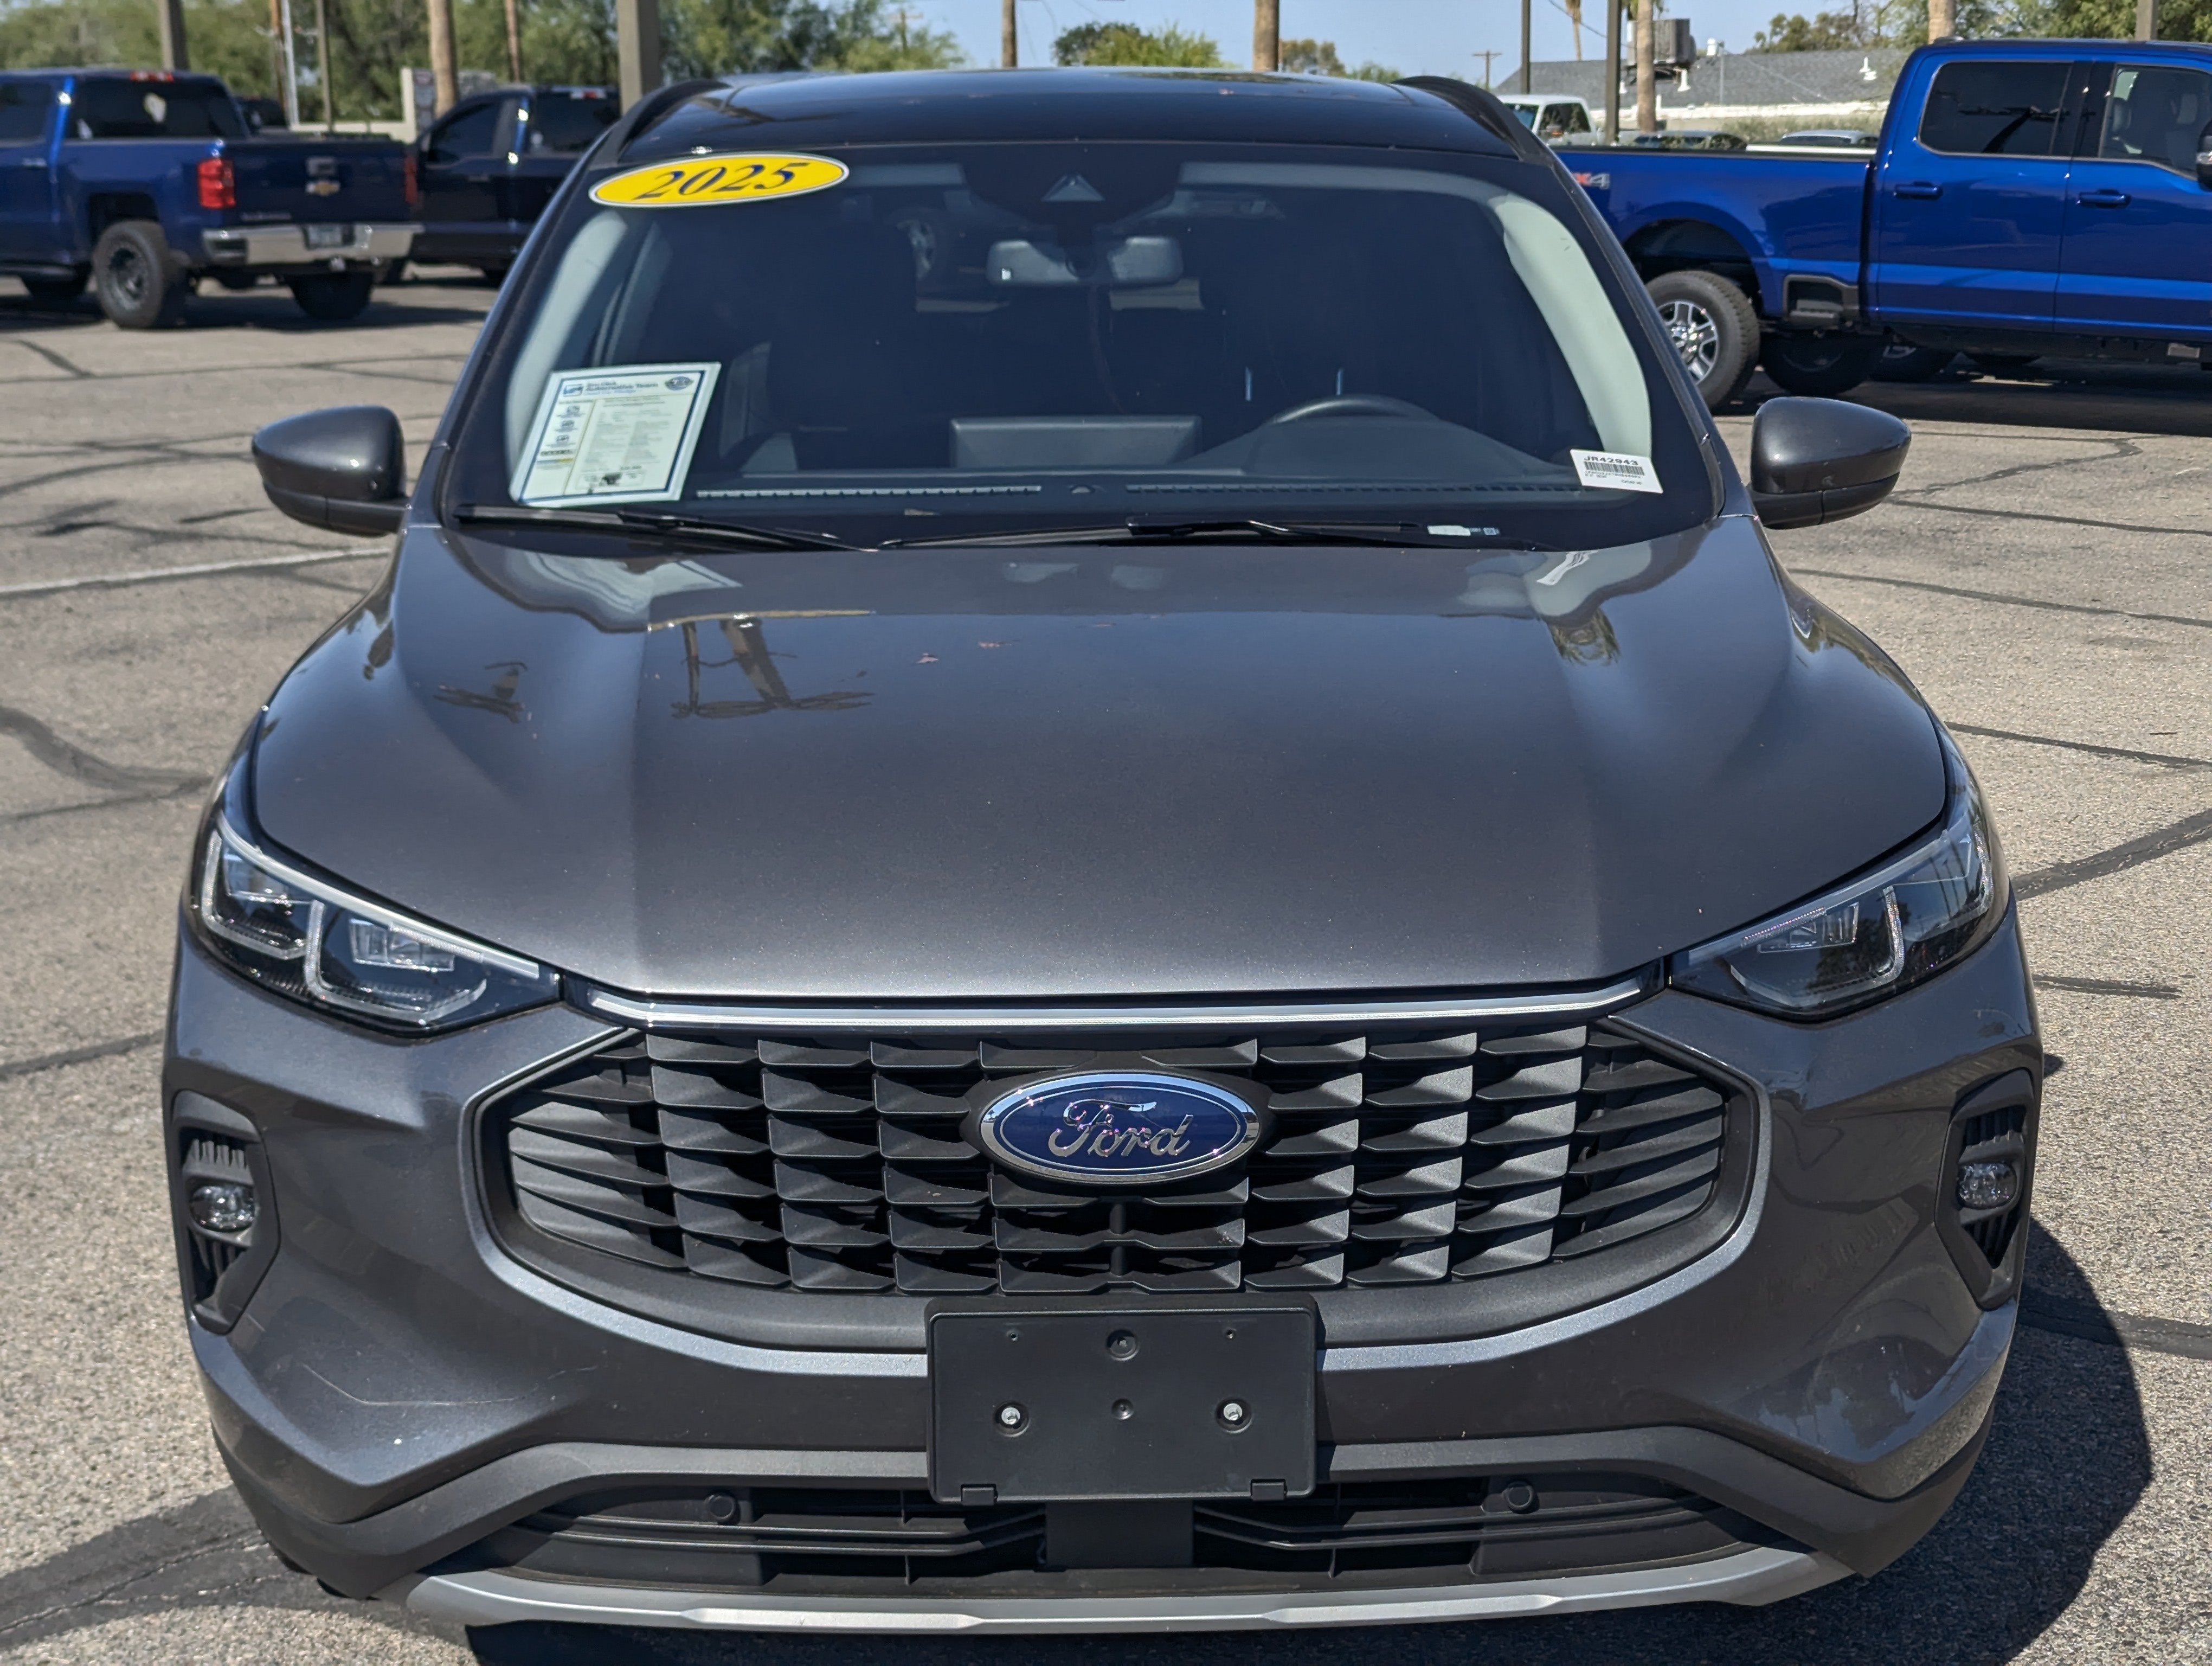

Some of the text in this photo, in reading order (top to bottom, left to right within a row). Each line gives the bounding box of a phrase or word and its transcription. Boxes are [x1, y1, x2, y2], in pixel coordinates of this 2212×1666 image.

[632, 162, 811, 200] 2025
[1573, 172, 1610, 189] X4
[1048, 1098, 1194, 1157] Ford
